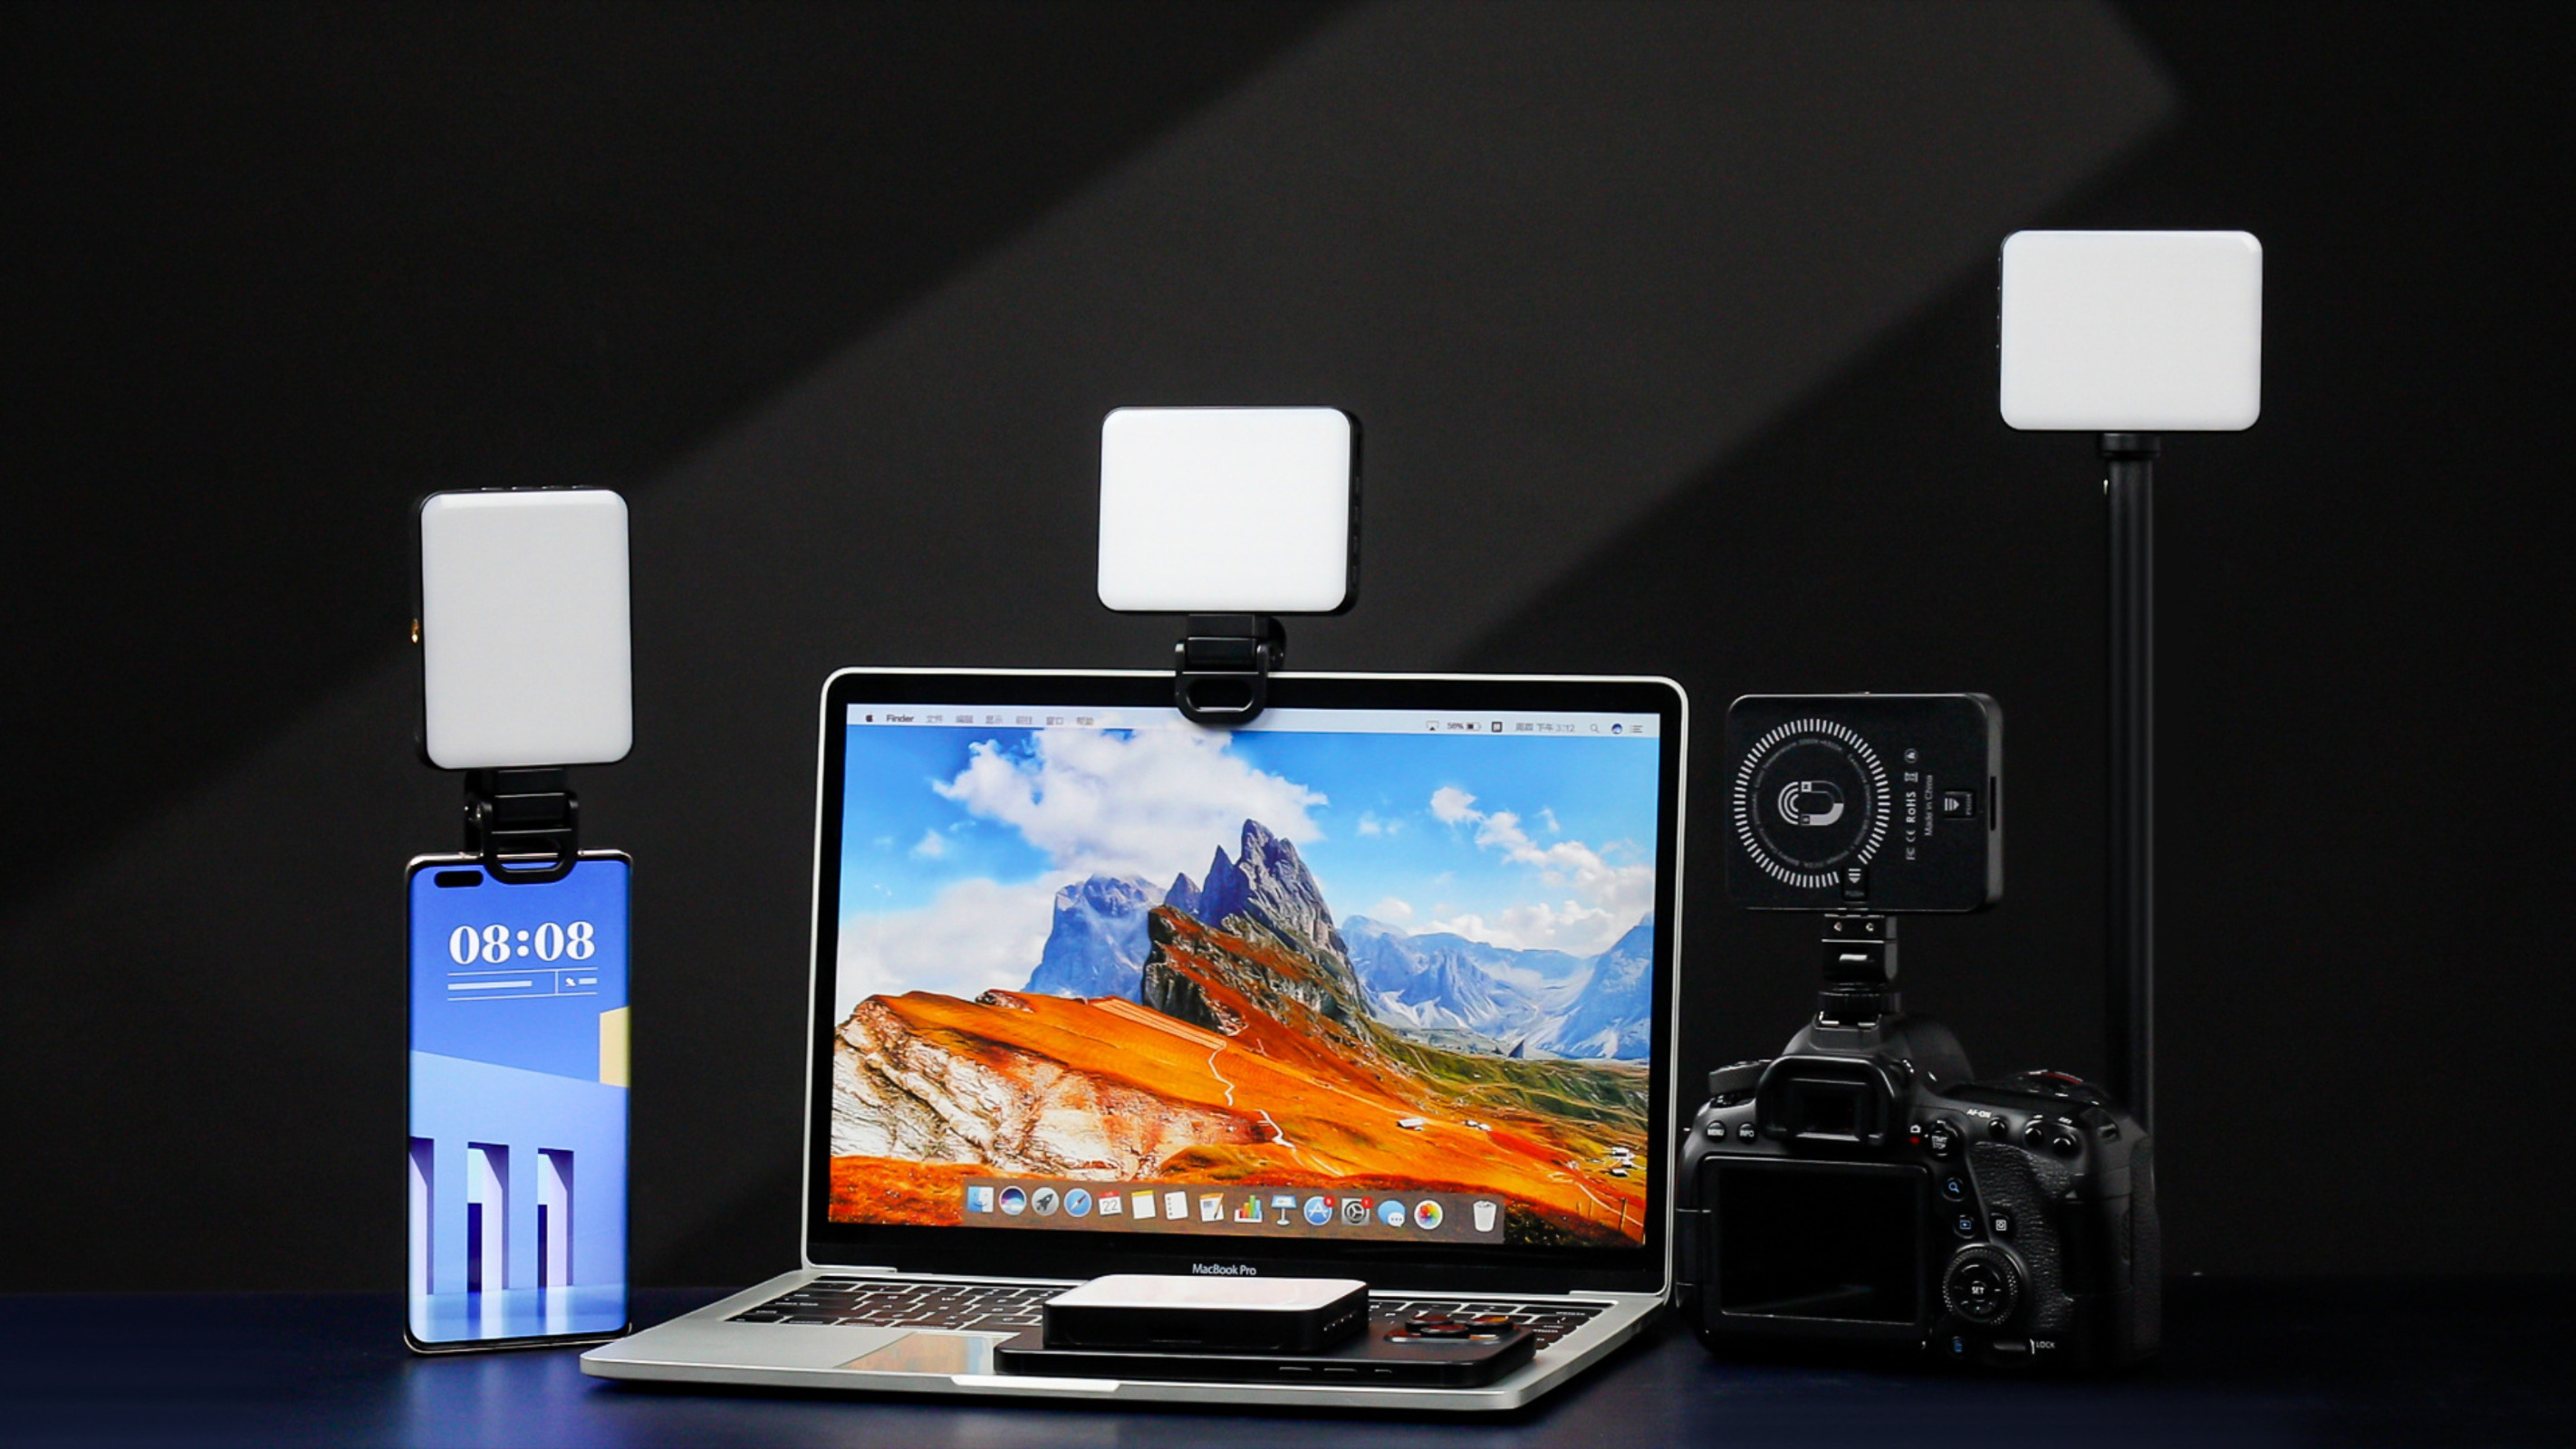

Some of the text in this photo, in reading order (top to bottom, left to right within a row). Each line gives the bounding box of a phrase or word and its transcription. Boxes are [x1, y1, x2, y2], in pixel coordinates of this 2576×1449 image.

[886, 714, 915, 724] Finder
[1906, 792, 1917, 823] RoHS
[1925, 775, 1933, 836] Made in China
[449, 921, 596, 965] 08:08
[1966, 1108, 1992, 1118] AF-ON
[1102, 1199, 1119, 1213] 22
[1192, 1262, 1257, 1276] MacBook Pro
[1972, 1286, 1985, 1294] SET
